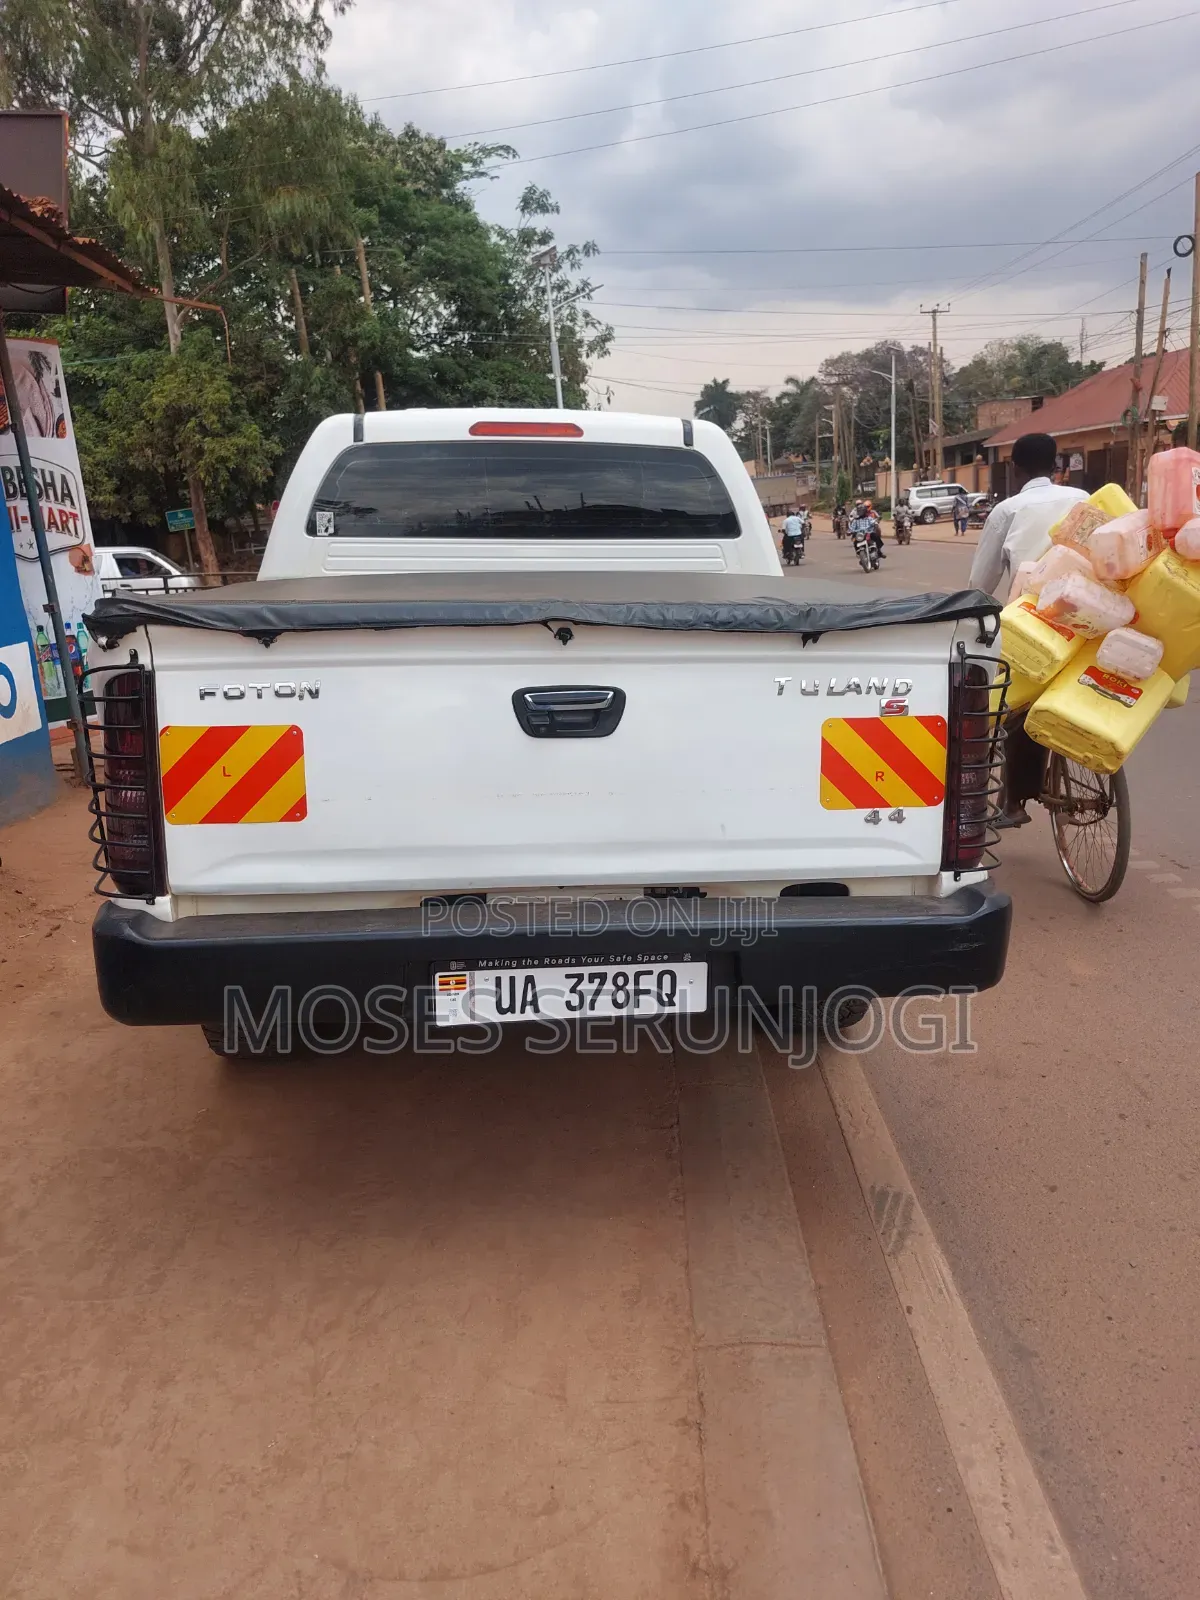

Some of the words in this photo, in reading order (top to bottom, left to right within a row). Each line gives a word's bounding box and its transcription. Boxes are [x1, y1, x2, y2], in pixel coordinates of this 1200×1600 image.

[200, 680, 321, 701] FOTON
[773, 676, 913, 696] TULAND
[222, 765, 232, 778] L
[875, 770, 885, 782] R
[478, 959, 518, 968] Making
[522, 957, 539, 966] the
[544, 956, 576, 965] Roads
[581, 955, 605, 964] Your
[609, 954, 633, 963] Safe
[637, 953, 669, 963] Space
[495, 974, 541, 1016] UA
[564, 969, 678, 1012] 378FQ
